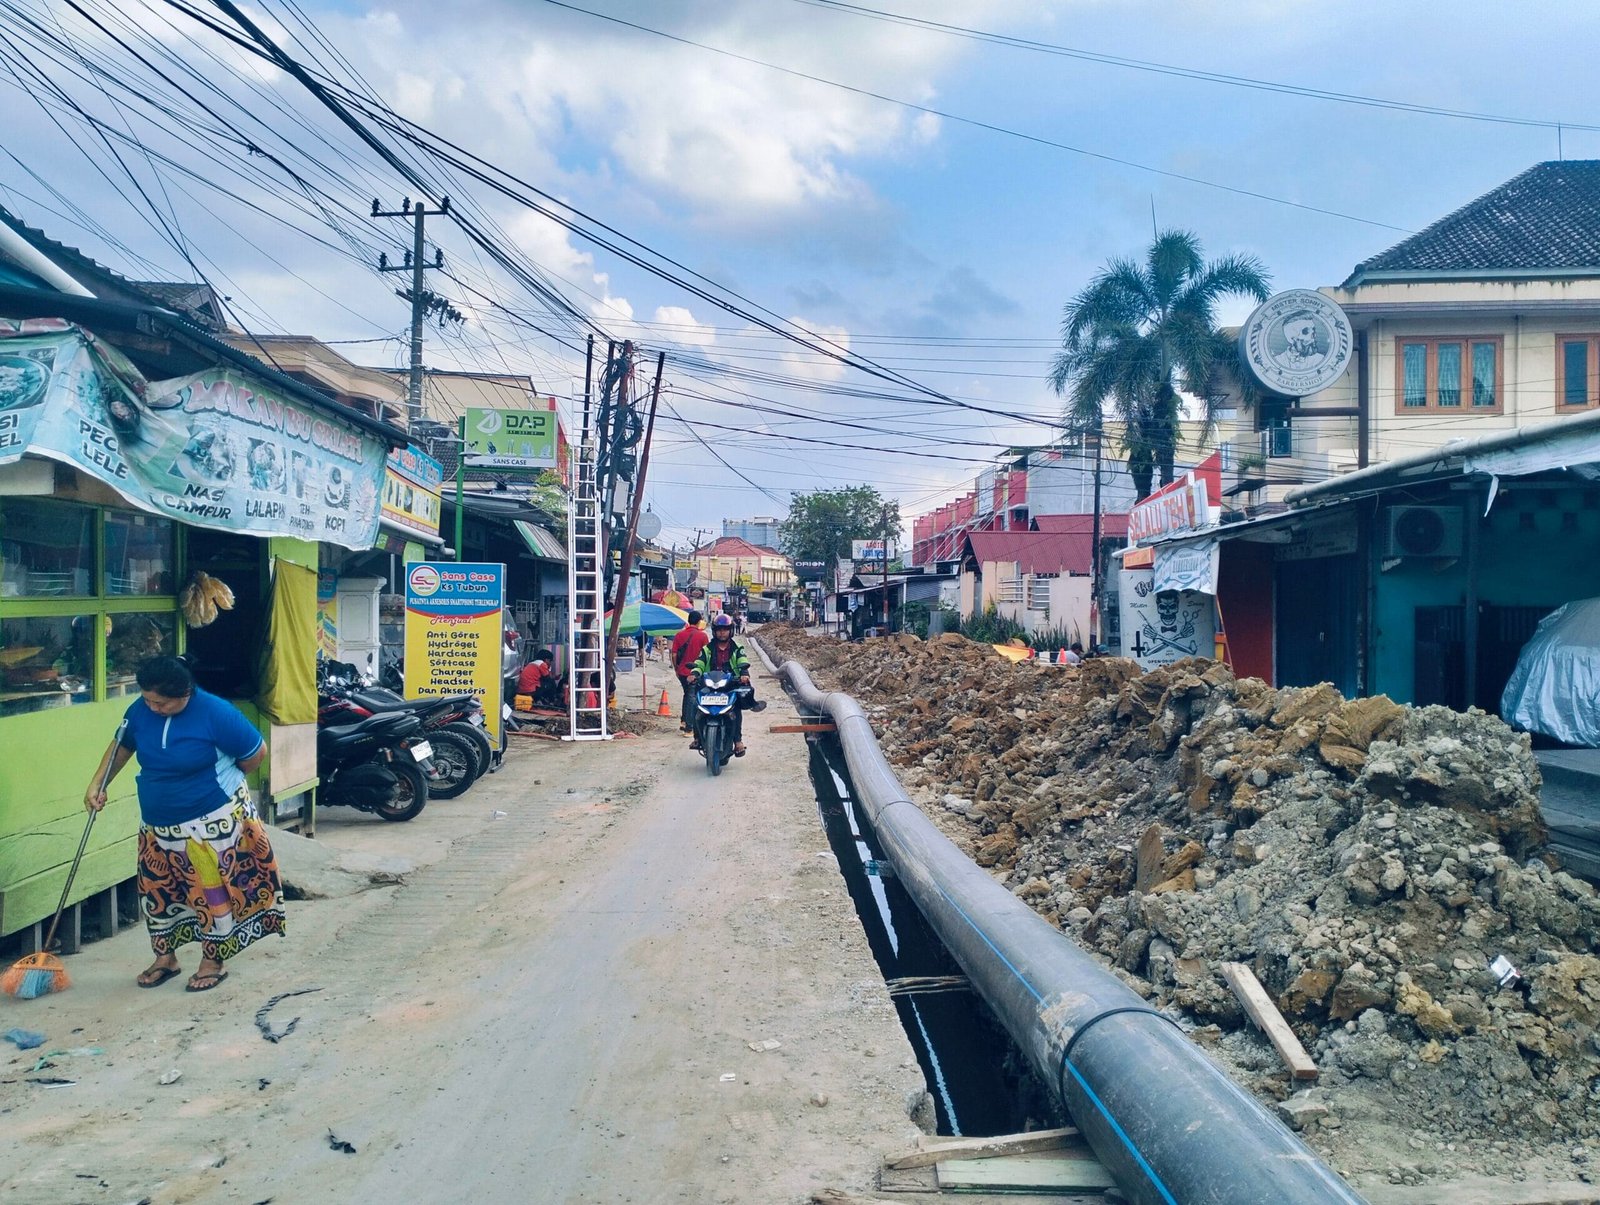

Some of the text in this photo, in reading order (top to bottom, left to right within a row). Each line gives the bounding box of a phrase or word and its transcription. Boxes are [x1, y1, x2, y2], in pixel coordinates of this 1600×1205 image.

[506, 415, 546, 428] DAP
[79, 420, 121, 453] PEC
[83, 442, 129, 479] LELE
[184, 483, 226, 501] NASI
[325, 514, 346, 531] KOPI
[442, 572, 496, 581] Sans Case
[441, 583, 487, 591] Ks Tubun
[427, 631, 480, 639] Anti Gores
[428, 640, 478, 649] Hydrogel
[430, 659, 475, 667] Softcase
[431, 668, 473, 676] Charger
